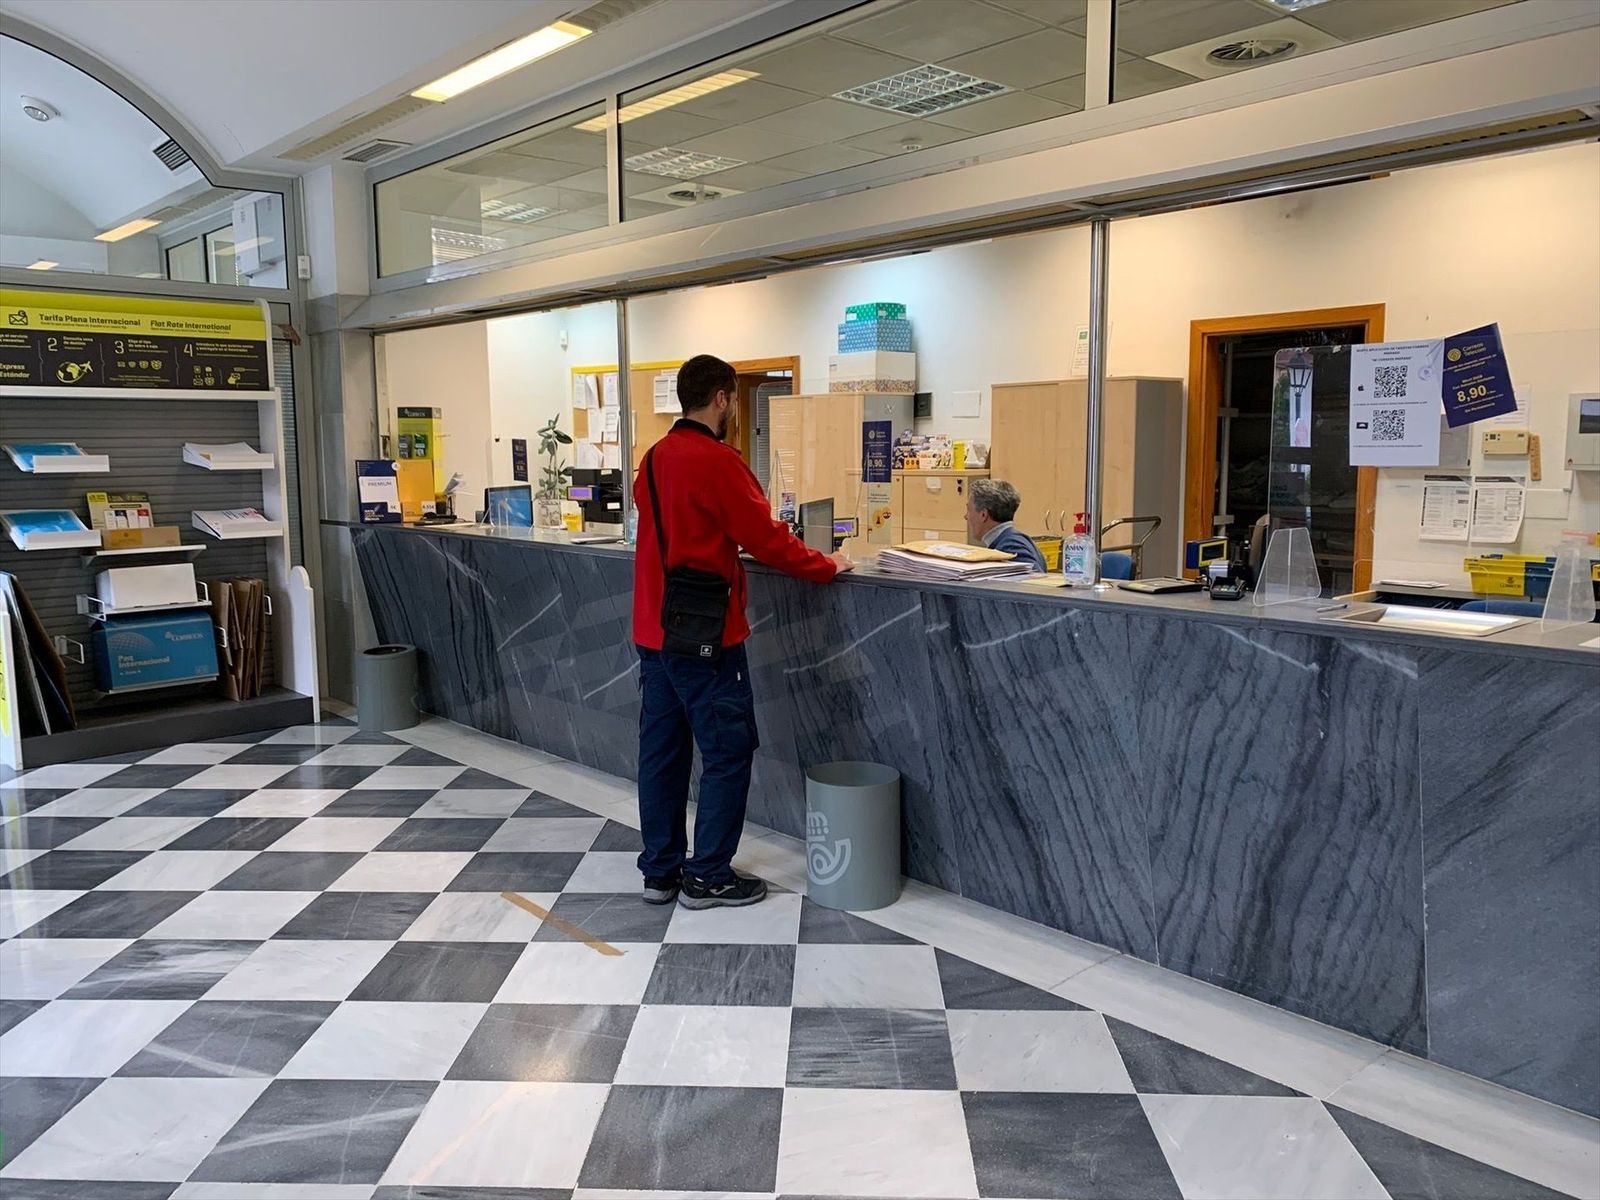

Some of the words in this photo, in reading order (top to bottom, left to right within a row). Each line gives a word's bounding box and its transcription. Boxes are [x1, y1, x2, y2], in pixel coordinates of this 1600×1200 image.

[39, 313, 64, 323] Tarifa
[65, 315, 88, 324] Plana
[89, 316, 141, 327] Internacional
[150, 319, 166, 328] Flat
[166, 321, 184, 330] Rate
[184, 321, 232, 332] International
[47, 337, 58, 352] 2
[114, 340, 125, 354] 3
[183, 343, 194, 358] 4
[1456, 385, 1487, 402] 8,90
